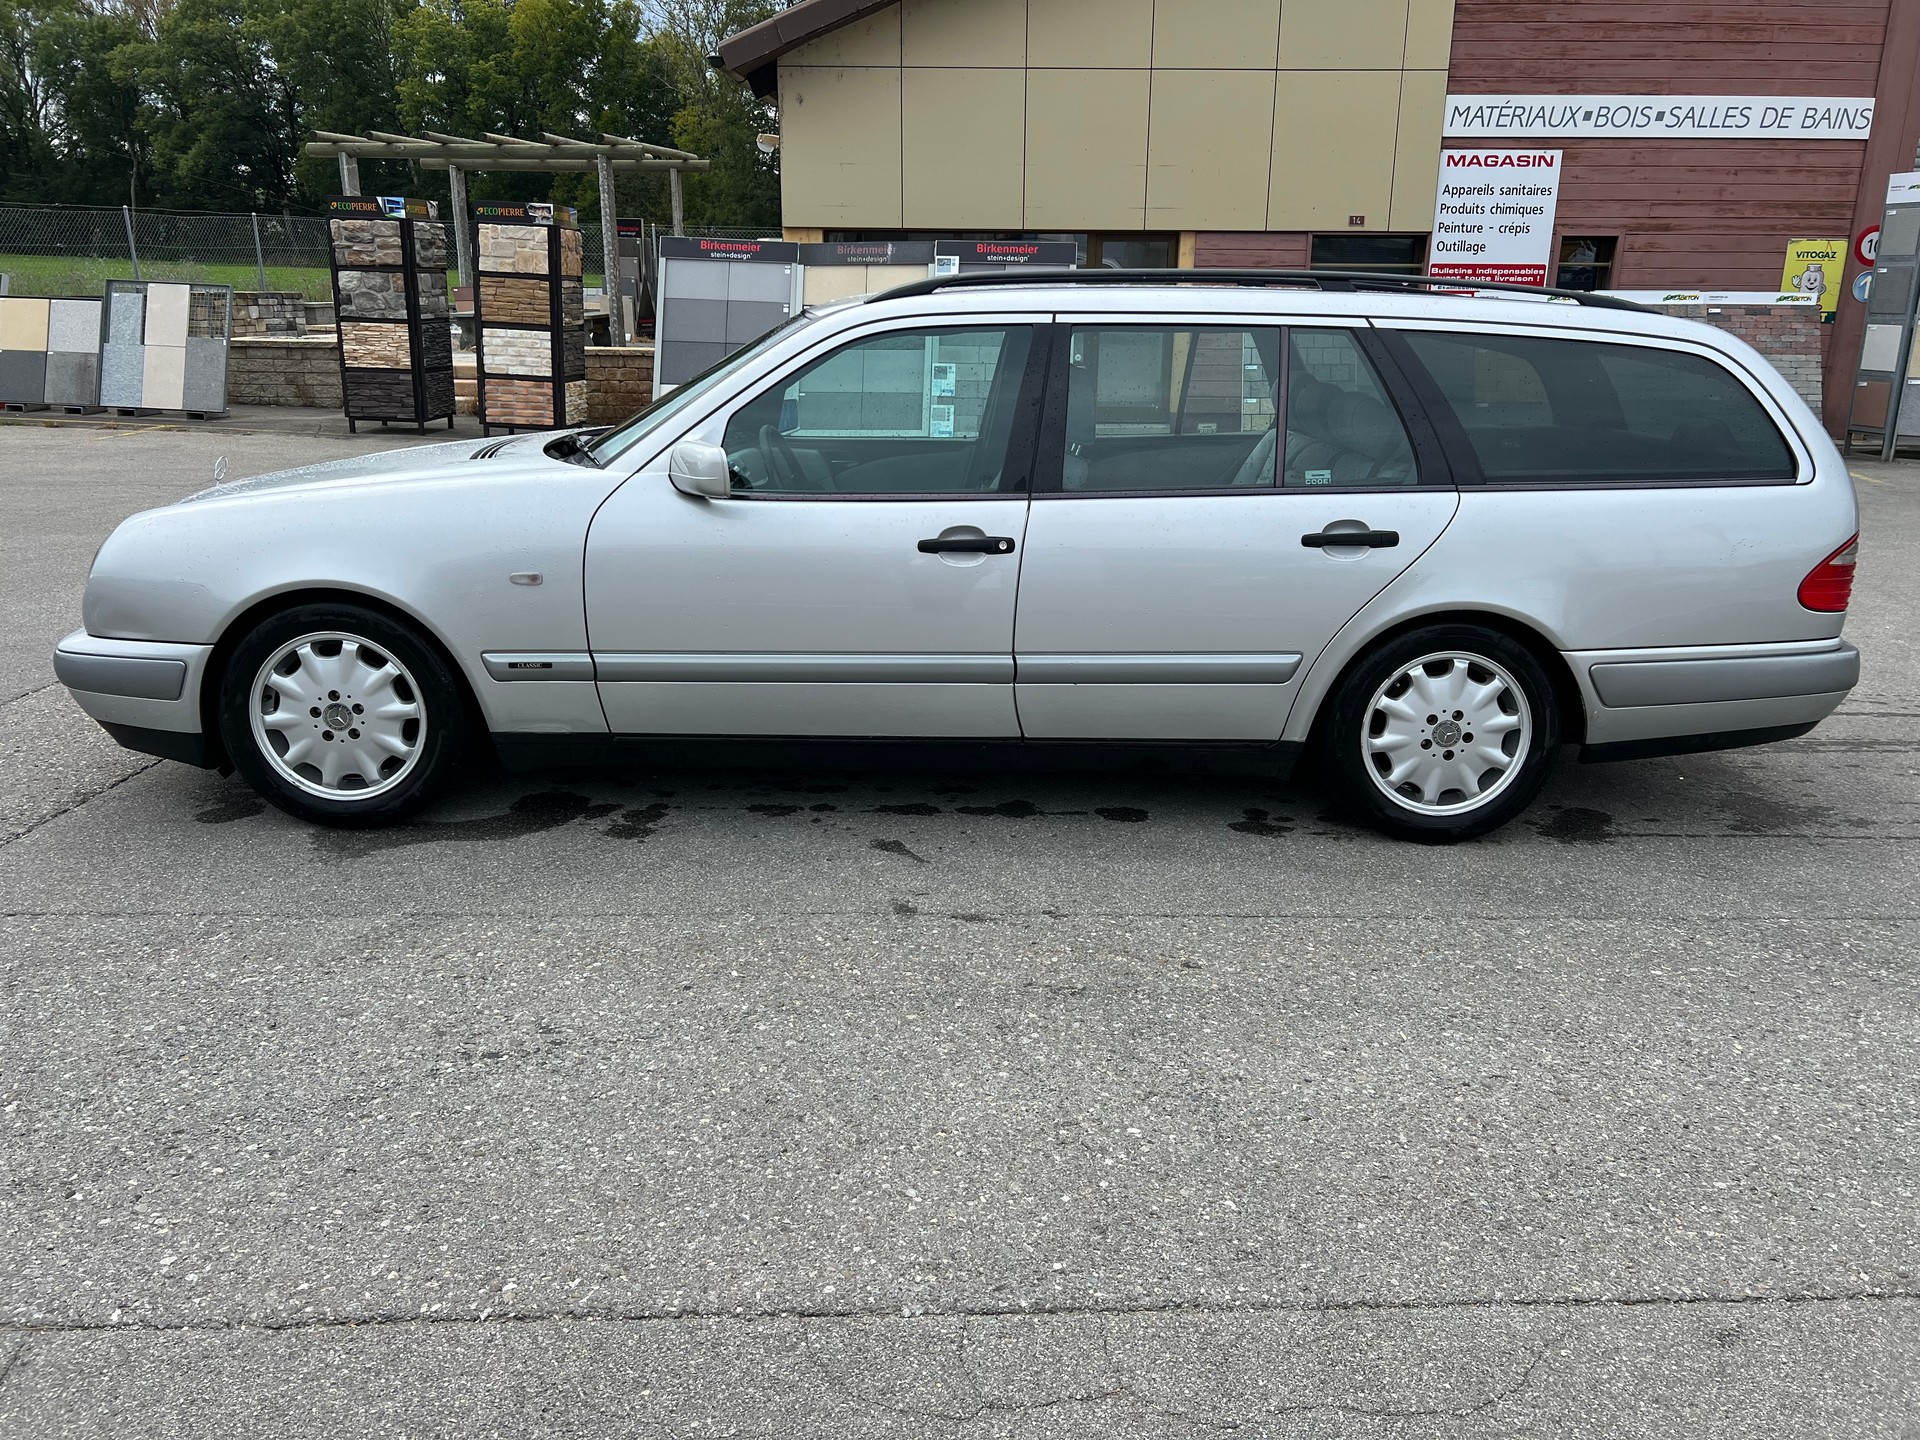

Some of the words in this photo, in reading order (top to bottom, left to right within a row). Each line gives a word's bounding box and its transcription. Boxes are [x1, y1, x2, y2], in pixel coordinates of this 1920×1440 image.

[1449, 100, 1582, 128] MATÉRIAUX
[1593, 106, 1653, 128] BOIS
[1665, 106, 1752, 129] SALLES
[1759, 107, 1795, 129] DE
[1800, 107, 1873, 130] BAINS
[1446, 155, 1555, 167] MAGASIN
[1442, 183, 1495, 199] Appareils
[1499, 183, 1553, 196] sanitaires
[337, 201, 378, 212] ECOPIERRE
[484, 207, 525, 217] ECOPIERRE
[1440, 202, 1485, 215] Produits
[1490, 203, 1544, 218] chimiques
[1437, 221, 1484, 234] Peinture
[1498, 221, 1531, 236] crépis
[700, 240, 761, 252] Birkenmeier
[837, 244, 896, 255] Birkenmeier
[976, 243, 1039, 254] Birkenmeier
[1436, 240, 1487, 255] Outillage
[1430, 267, 1472, 275] Bulletins
[1476, 267, 1545, 276] indispensables
